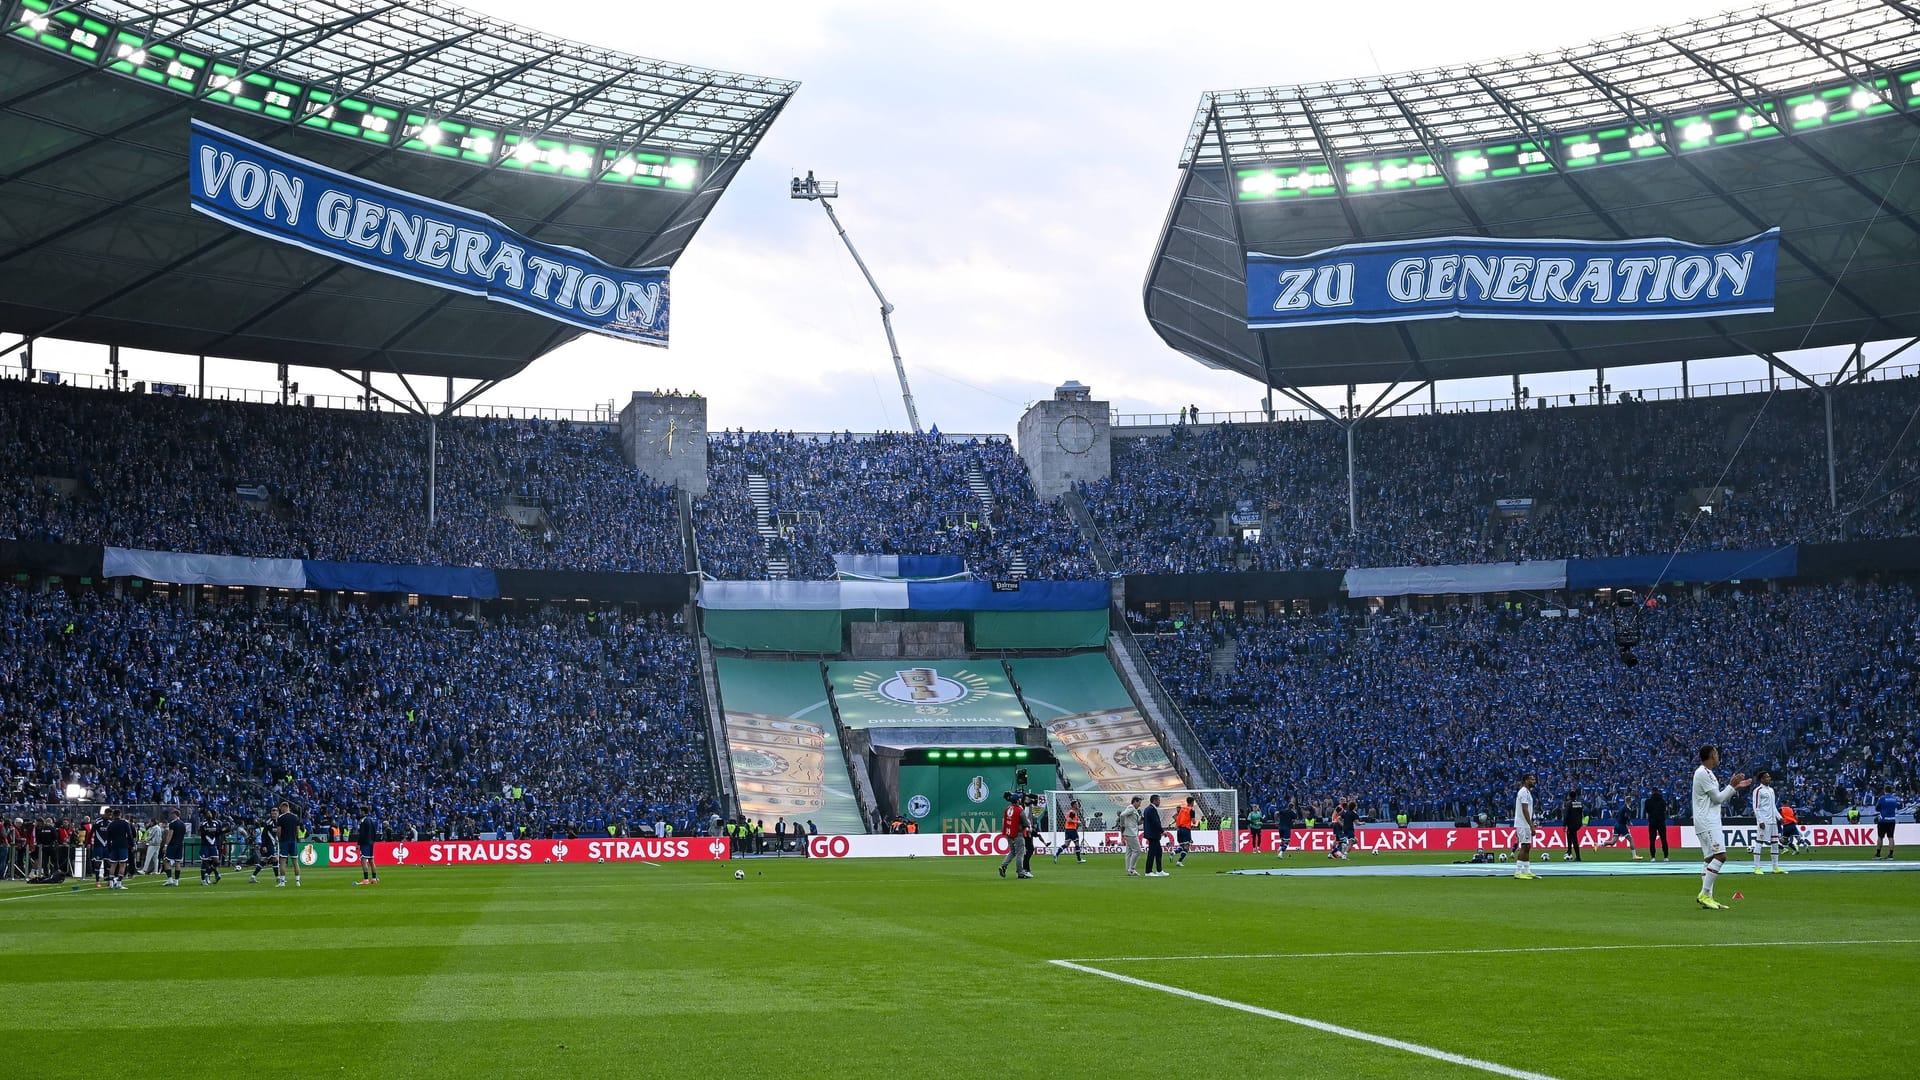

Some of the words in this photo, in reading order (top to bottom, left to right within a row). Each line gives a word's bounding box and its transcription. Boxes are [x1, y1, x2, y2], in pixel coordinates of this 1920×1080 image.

[200, 145, 304, 226] VON
[317, 189, 659, 327] GENERATION
[1273, 263, 1353, 311] ZU
[1386, 251, 1754, 304] GENERATION
[942, 818, 1004, 833] FINAL
[942, 834, 1010, 856] ERGO
[1813, 828, 1874, 846] BANK
[429, 843, 531, 862] STRAUSS
[588, 840, 689, 859] STRAUSS
